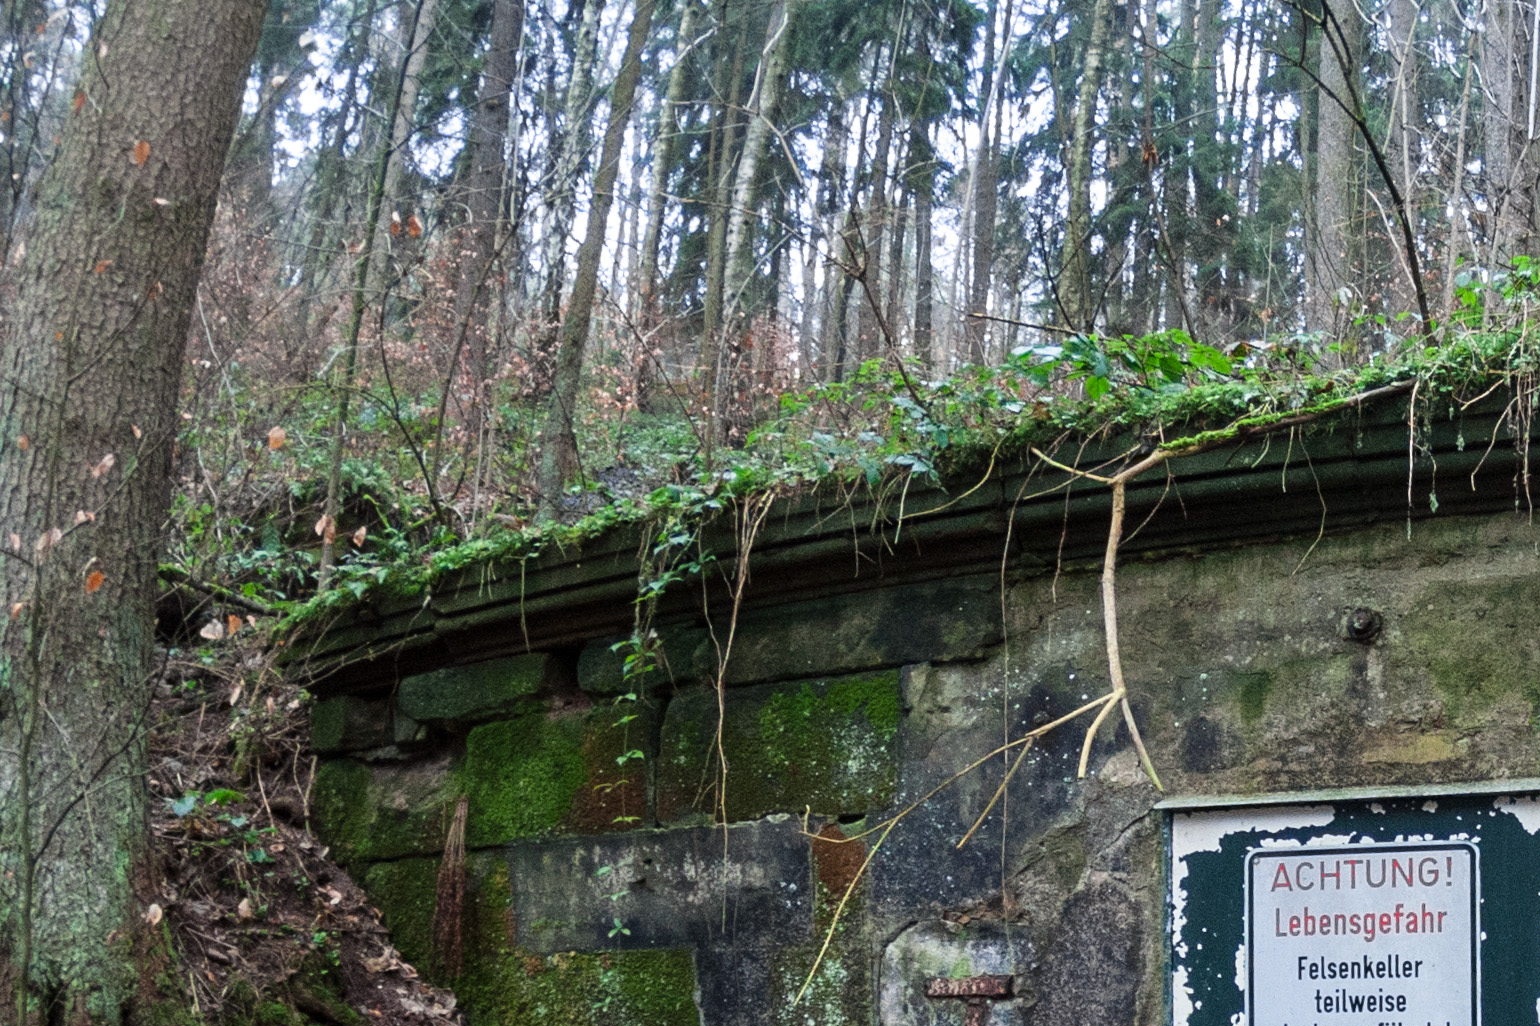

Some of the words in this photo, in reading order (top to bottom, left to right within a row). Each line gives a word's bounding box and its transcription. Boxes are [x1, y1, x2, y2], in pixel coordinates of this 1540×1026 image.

[1270, 856, 1453, 892] ACHTUNG!
[1275, 903, 1448, 942] Lebensgefahr
[1297, 954, 1423, 981] Felsenkeller
[1314, 988, 1407, 1013] teilweise
